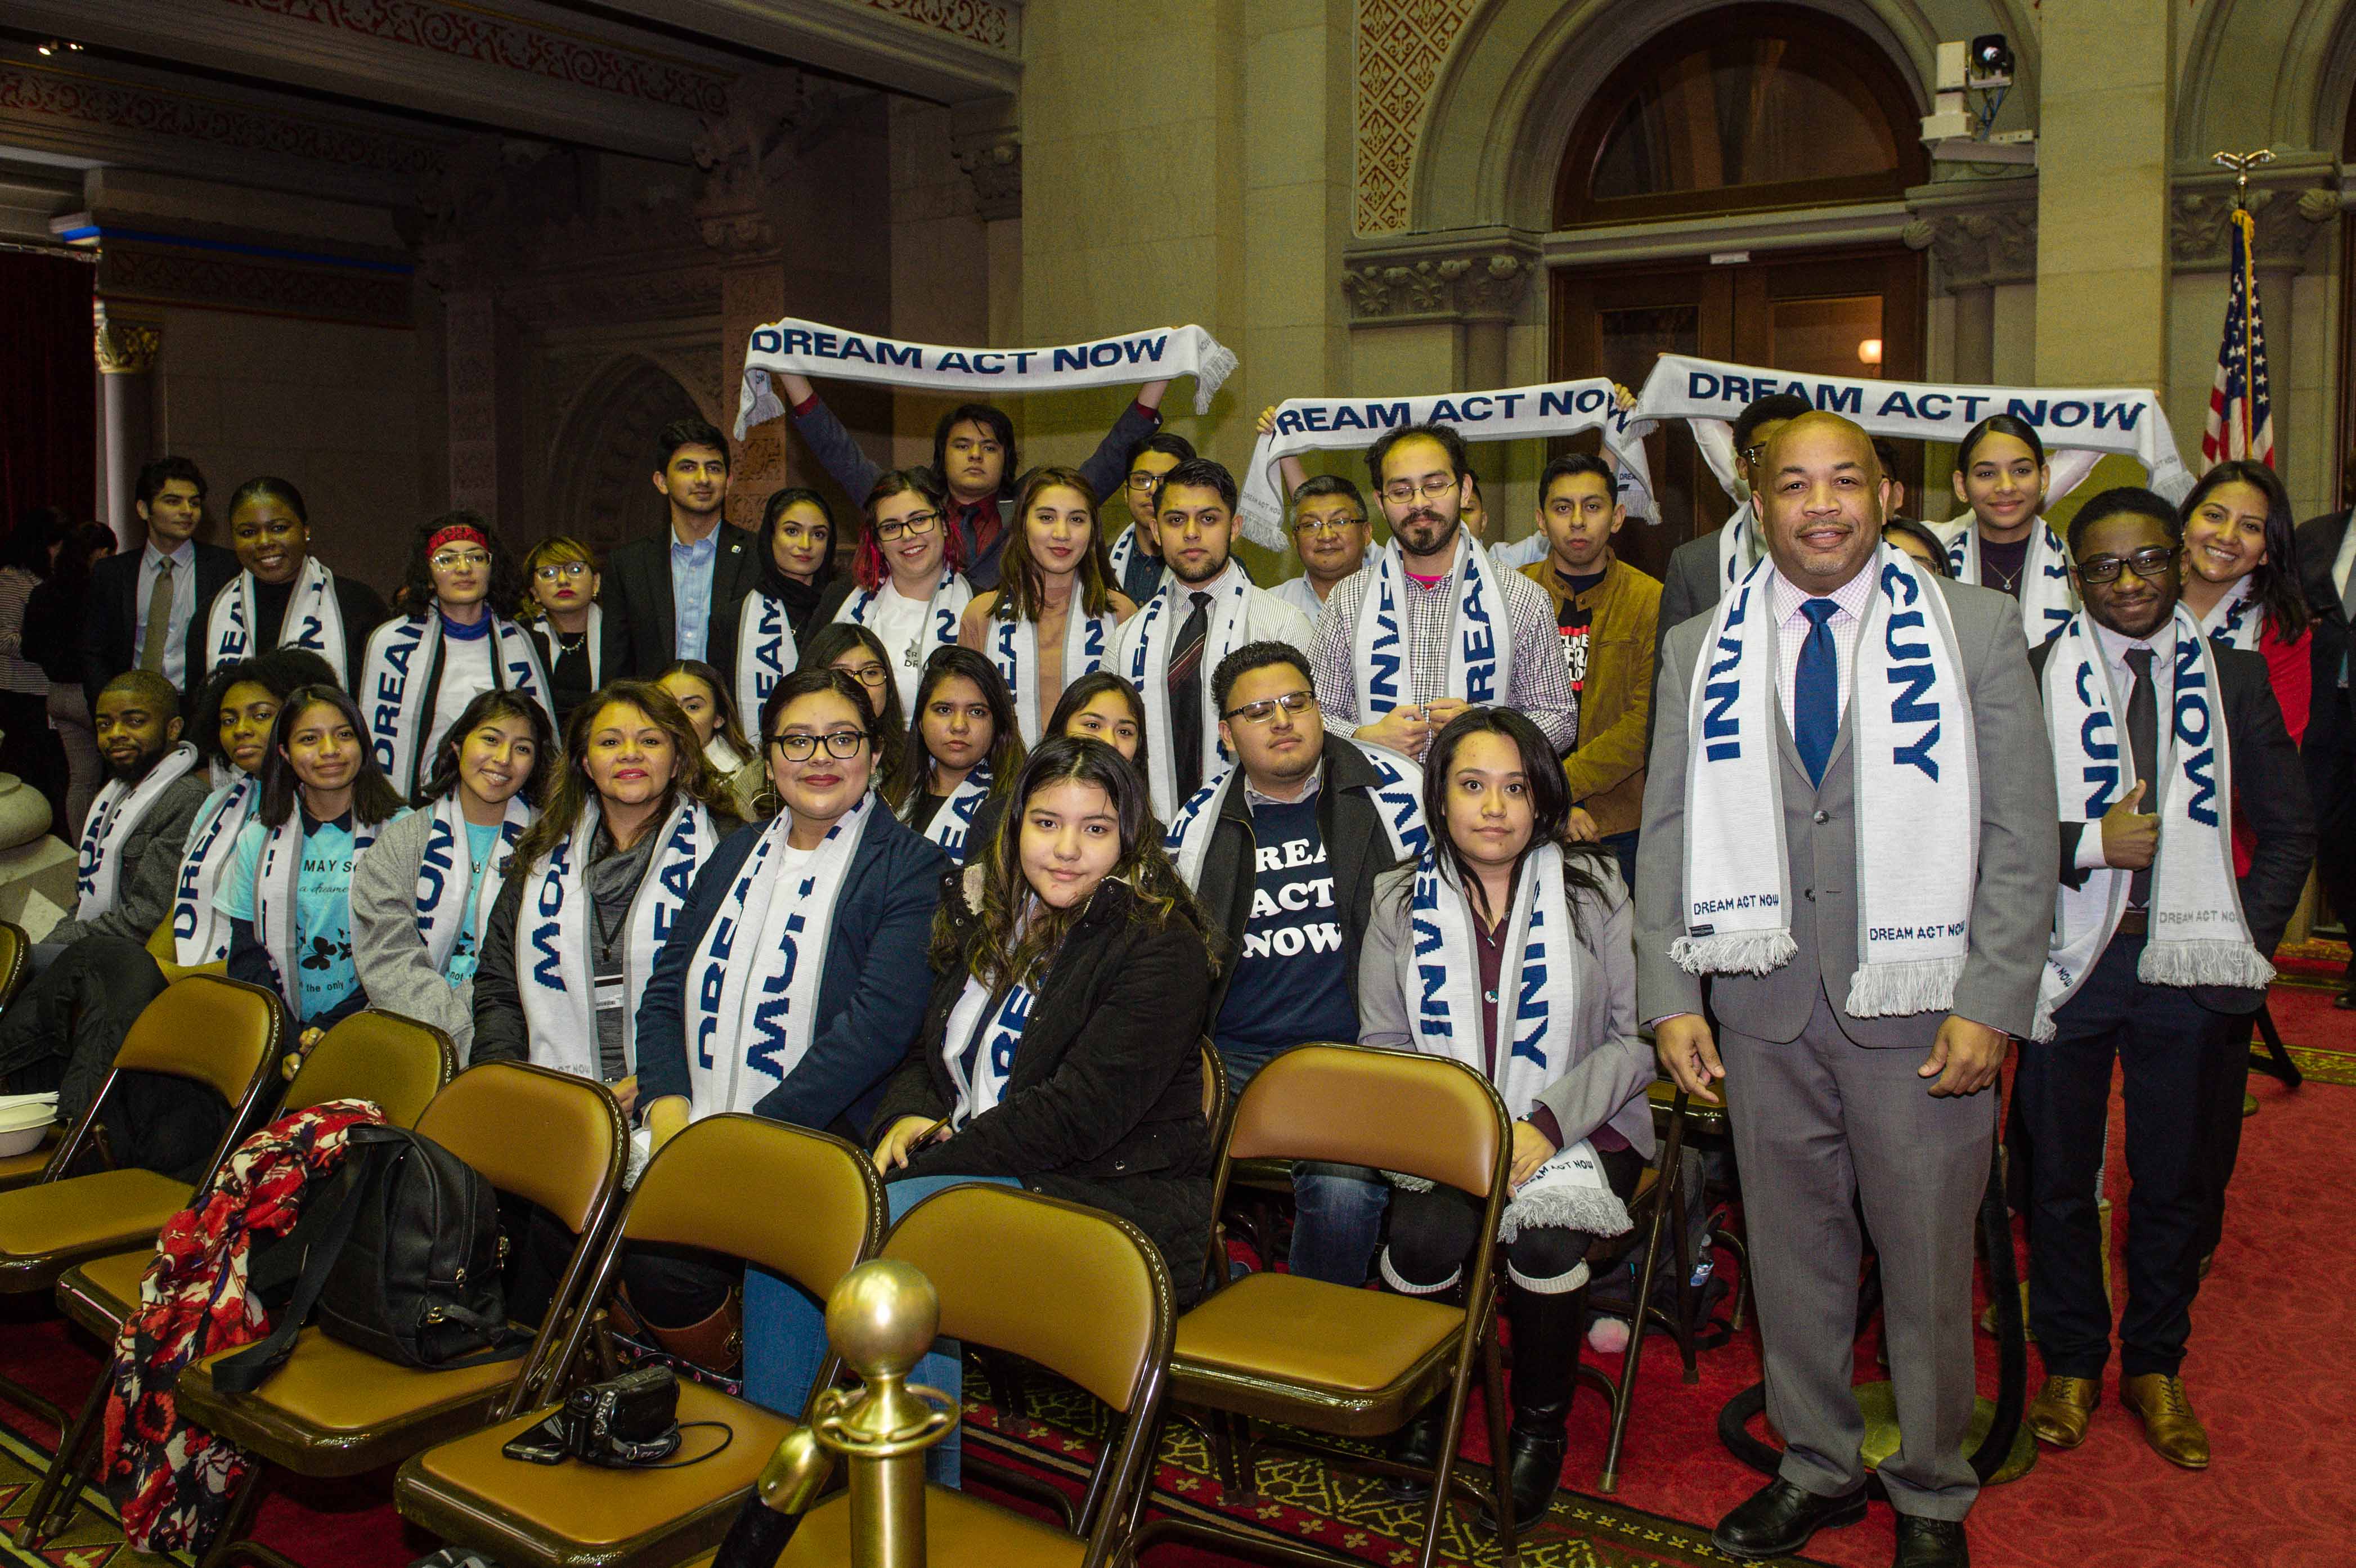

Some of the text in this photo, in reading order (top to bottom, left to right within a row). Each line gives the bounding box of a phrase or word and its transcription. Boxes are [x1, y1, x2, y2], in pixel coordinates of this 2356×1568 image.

[752, 329, 1168, 375] DREAM ACT NOW
[1689, 371, 2147, 431] DREAM ACT NOW
[1273, 402, 1412, 437] REAM
[1429, 395, 1525, 424] ACT
[1881, 562, 1941, 784] CUNY
[2075, 660, 2120, 819] CUN
[2175, 636, 2219, 828] NOW
[304, 859, 337, 873] MAY
[1250, 877, 1334, 919] ACT
[1693, 894, 1779, 915] DREAM ACT NOW
[2159, 911, 2193, 924] DREAM
[2196, 910, 2218, 922] ACT
[1242, 923, 1343, 958] NOW
[1869, 919, 1965, 941] DREAM ACT NOW
[306, 983, 321, 992] the
[327, 980, 344, 990] only
[450, 972, 464, 982] not
[2057, 967, 2074, 987] NOW
[573, 1063, 590, 1074] NOW
[1573, 1160, 1594, 1170] NOW
